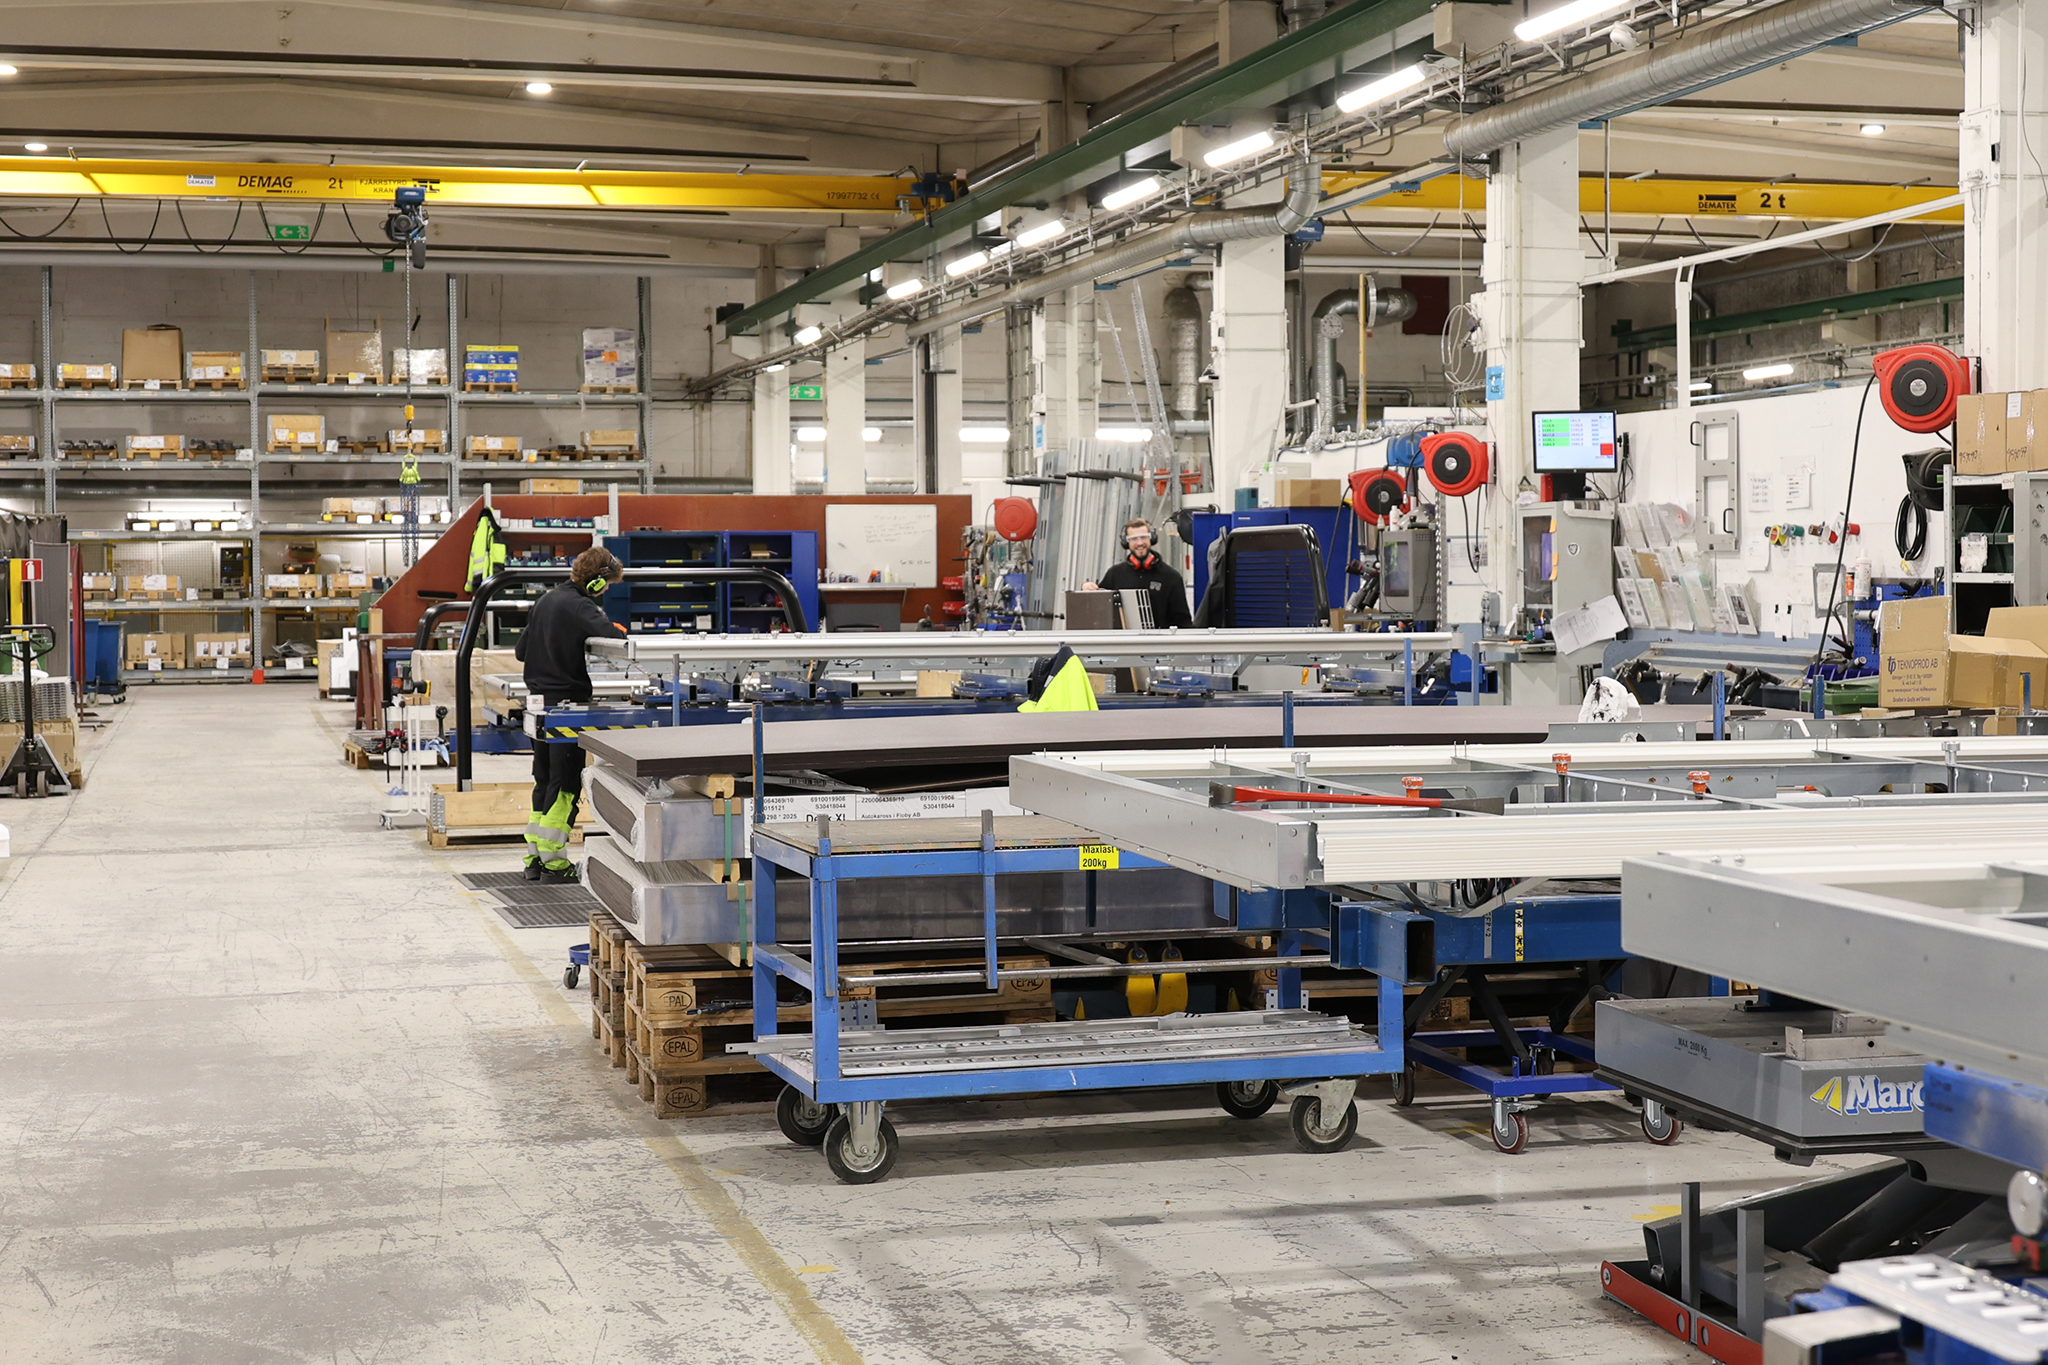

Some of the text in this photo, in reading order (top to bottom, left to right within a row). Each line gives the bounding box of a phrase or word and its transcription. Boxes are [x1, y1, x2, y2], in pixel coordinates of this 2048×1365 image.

[238, 175, 293, 188] DEMAG
[826, 192, 867, 200] 17997732
[1698, 201, 1737, 209] DEMATEK
[1897, 658, 1938, 670] TEKNOPROD AB
[896, 812, 911, 820] Floby
[1082, 858, 1107, 869] 200kg
[664, 995, 687, 1007] EPAL
[668, 1041, 693, 1054] EPAL
[671, 1091, 695, 1105] EPAL
